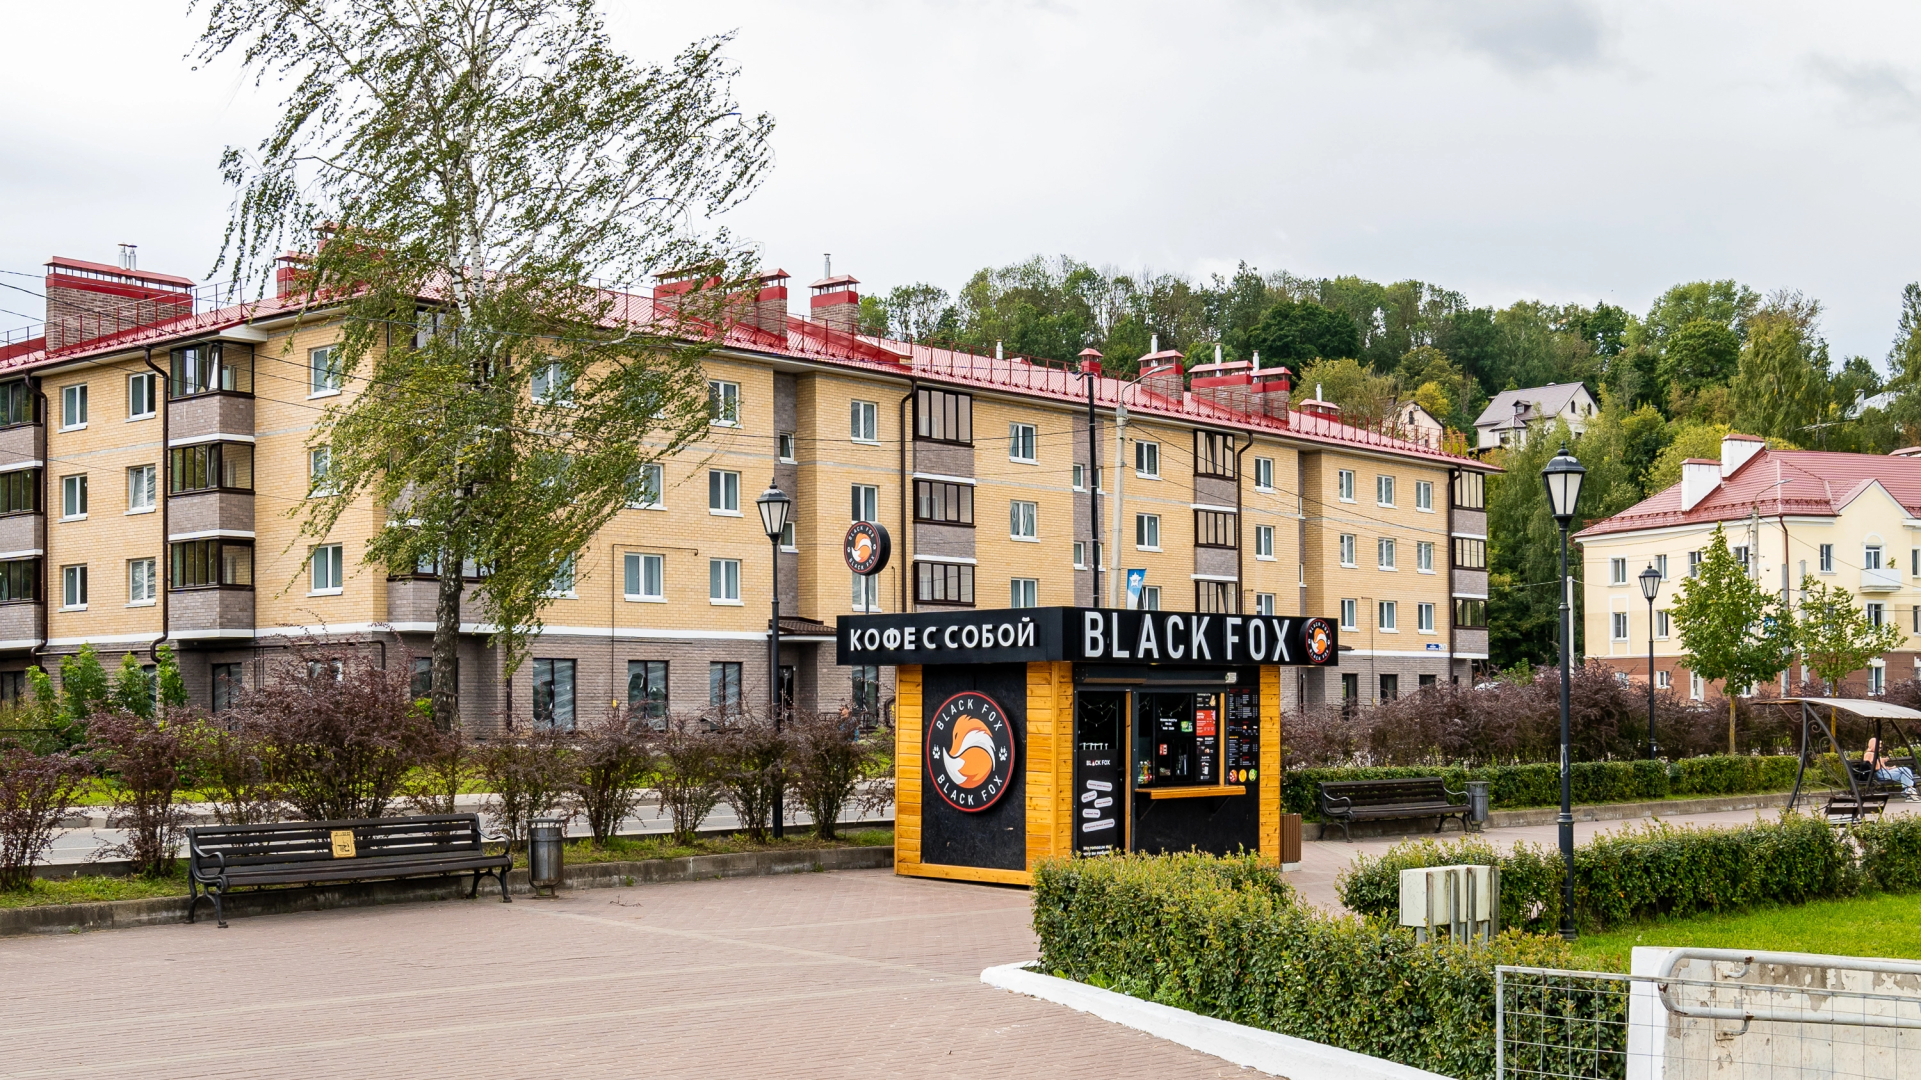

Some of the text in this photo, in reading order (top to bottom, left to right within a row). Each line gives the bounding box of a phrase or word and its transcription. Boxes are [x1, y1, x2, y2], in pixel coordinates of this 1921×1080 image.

[848, 526, 875, 540] BLACK FOX
[848, 556, 875, 570] BLACK FOX
[850, 616, 1035, 651] КОФЕ С СОБОЙ
[1084, 611, 1290, 662] BLACK FOX
[936, 698, 1003, 731] BLACK FOX
[1085, 759, 1101, 767] BLACK
[937, 773, 1003, 806] BLACK FOX
